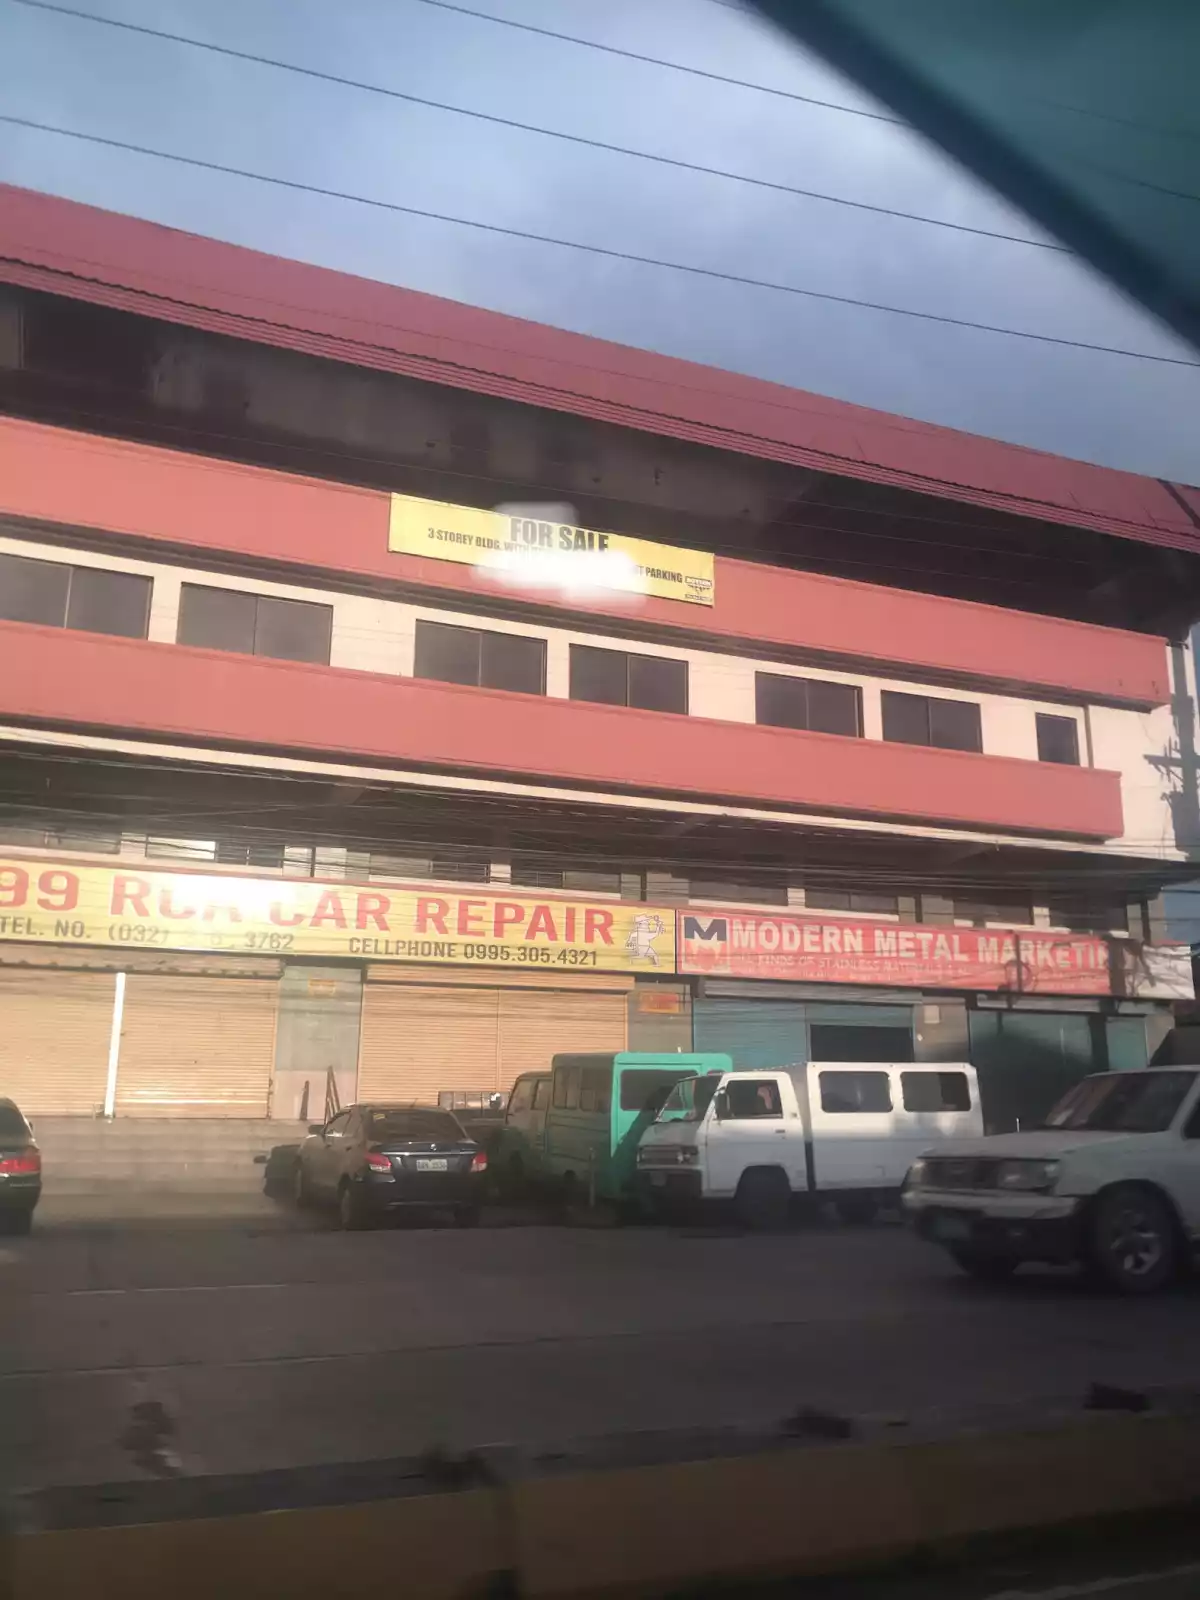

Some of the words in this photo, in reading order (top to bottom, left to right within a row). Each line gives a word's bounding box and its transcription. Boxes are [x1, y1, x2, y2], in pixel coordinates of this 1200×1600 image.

[428, 528, 435, 539] 3
[437, 529, 474, 546] STOREY
[510, 518, 553, 548] FOR
[558, 526, 609, 552] SALE
[645, 566, 683, 584] PARKING
[0, 915, 45, 937] TEL.
[54, 918, 91, 939] NO.
[268, 888, 391, 932] CAR
[415, 896, 615, 945] REPAIR
[349, 937, 456, 958] CELLPHONE
[463, 943, 597, 966] 0995.305.4321
[732, 919, 863, 955] MODERN
[874, 929, 970, 962] METAL
